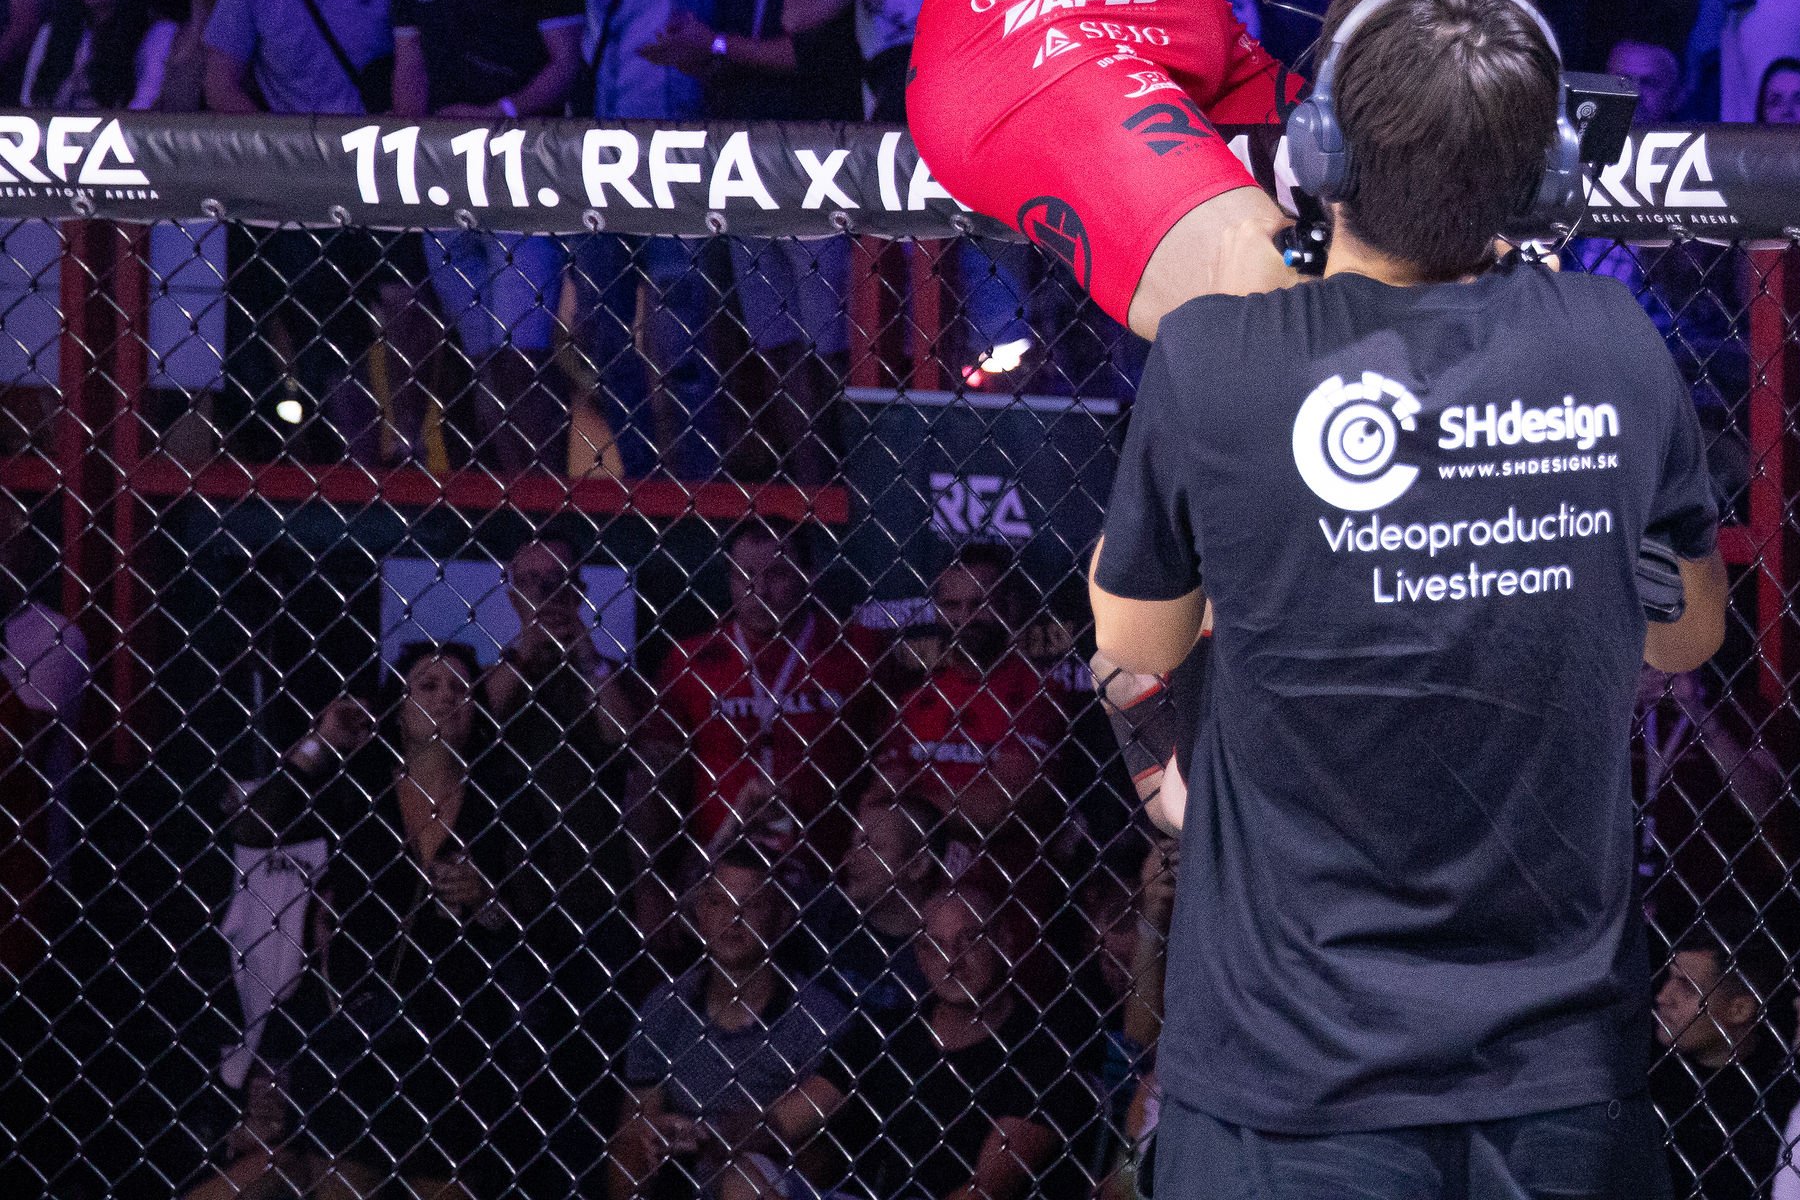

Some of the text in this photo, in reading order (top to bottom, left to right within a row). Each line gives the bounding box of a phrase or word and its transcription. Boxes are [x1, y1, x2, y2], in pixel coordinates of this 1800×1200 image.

[0, 116, 150, 186] RFA
[341, 126, 559, 209] 11.11.
[582, 128, 781, 212] RFA
[1582, 132, 1728, 208] RFA
[0, 187, 37, 198] EAL
[105, 189, 159, 201] ARENA
[1592, 213, 1740, 225] REAL FIGHT ARENA
[1437, 394, 1620, 451] SHdesign
[1437, 454, 1619, 480] WWW.SHDESIGN.SK
[929, 472, 1035, 538] RFA
[1318, 502, 1613, 558] Videoproduction
[1373, 561, 1573, 603] Livestream
